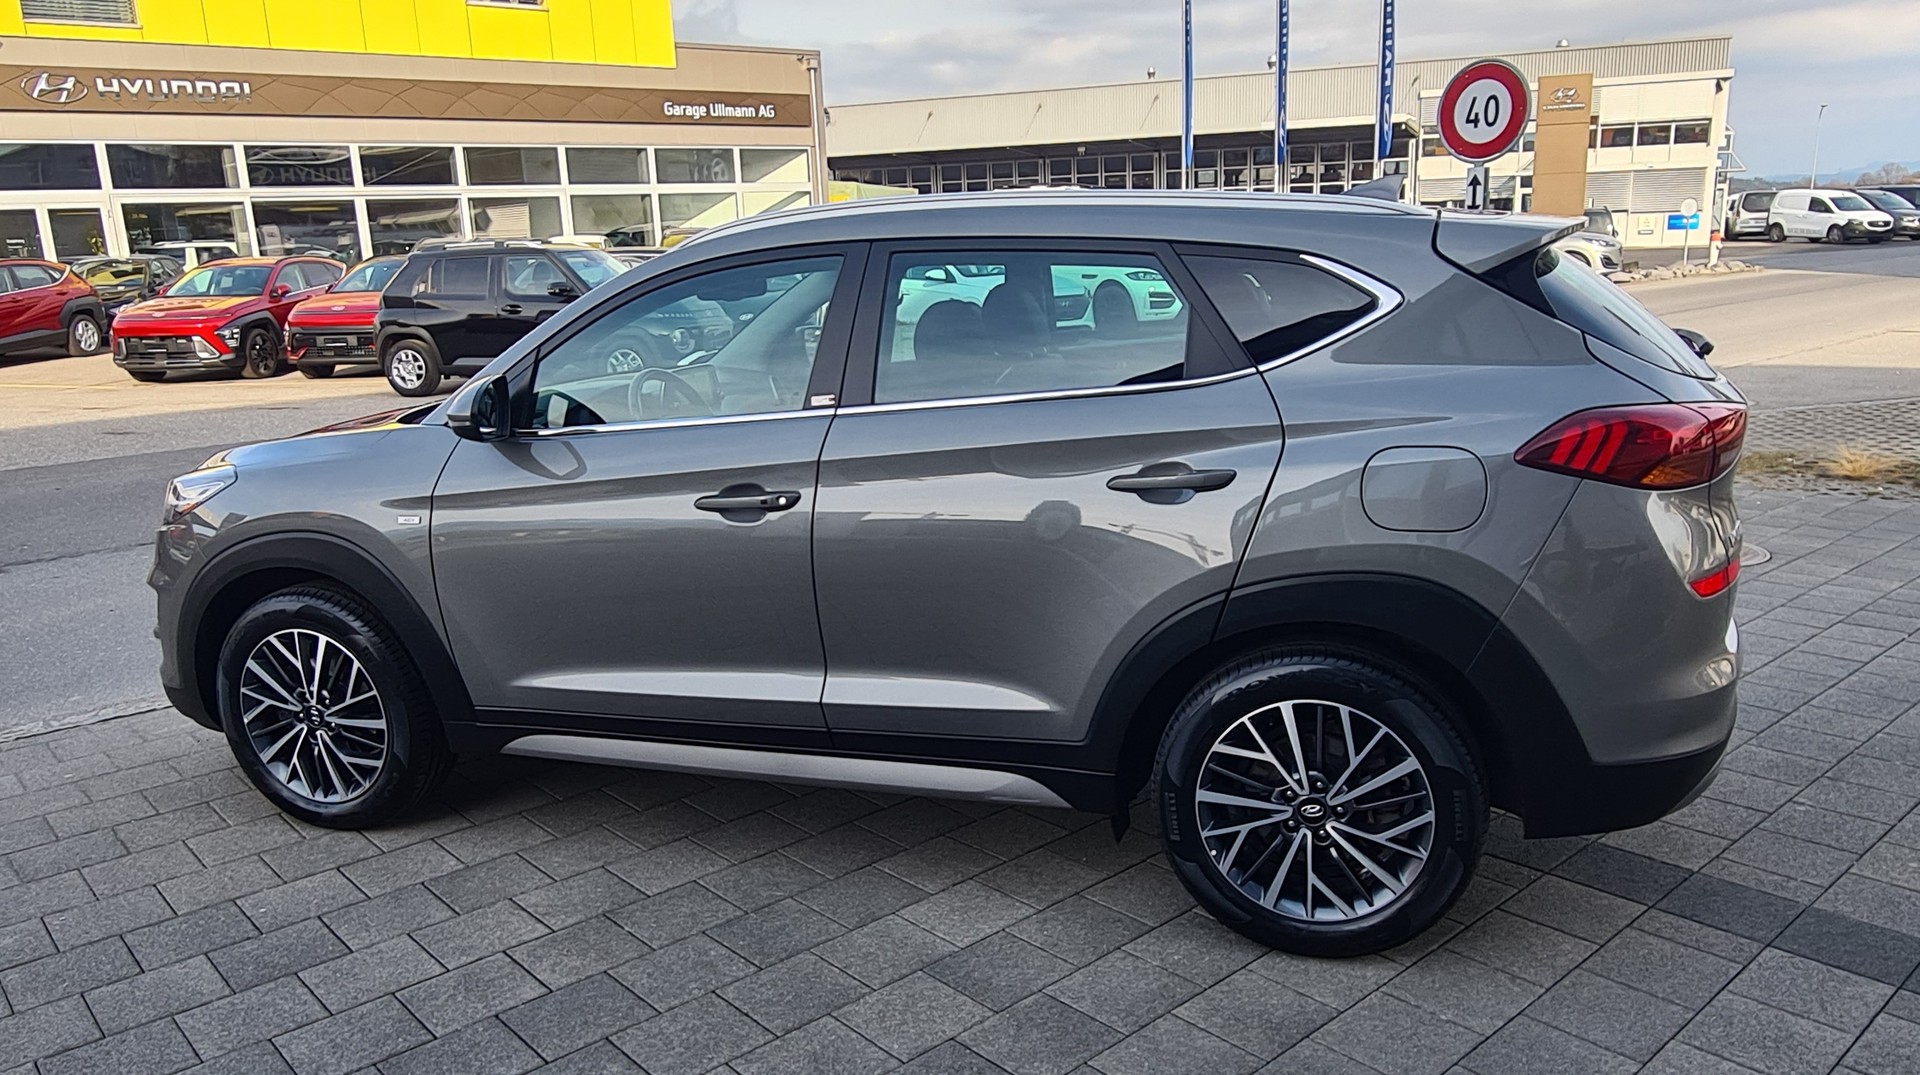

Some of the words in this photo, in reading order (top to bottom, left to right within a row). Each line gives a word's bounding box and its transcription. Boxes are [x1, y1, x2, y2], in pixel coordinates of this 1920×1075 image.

[95, 77, 252, 103] HYUNDAI
[663, 101, 707, 119] Garage
[709, 103, 756, 117] Ullmann
[758, 104, 775, 118] AG
[1465, 94, 1500, 129] 40
